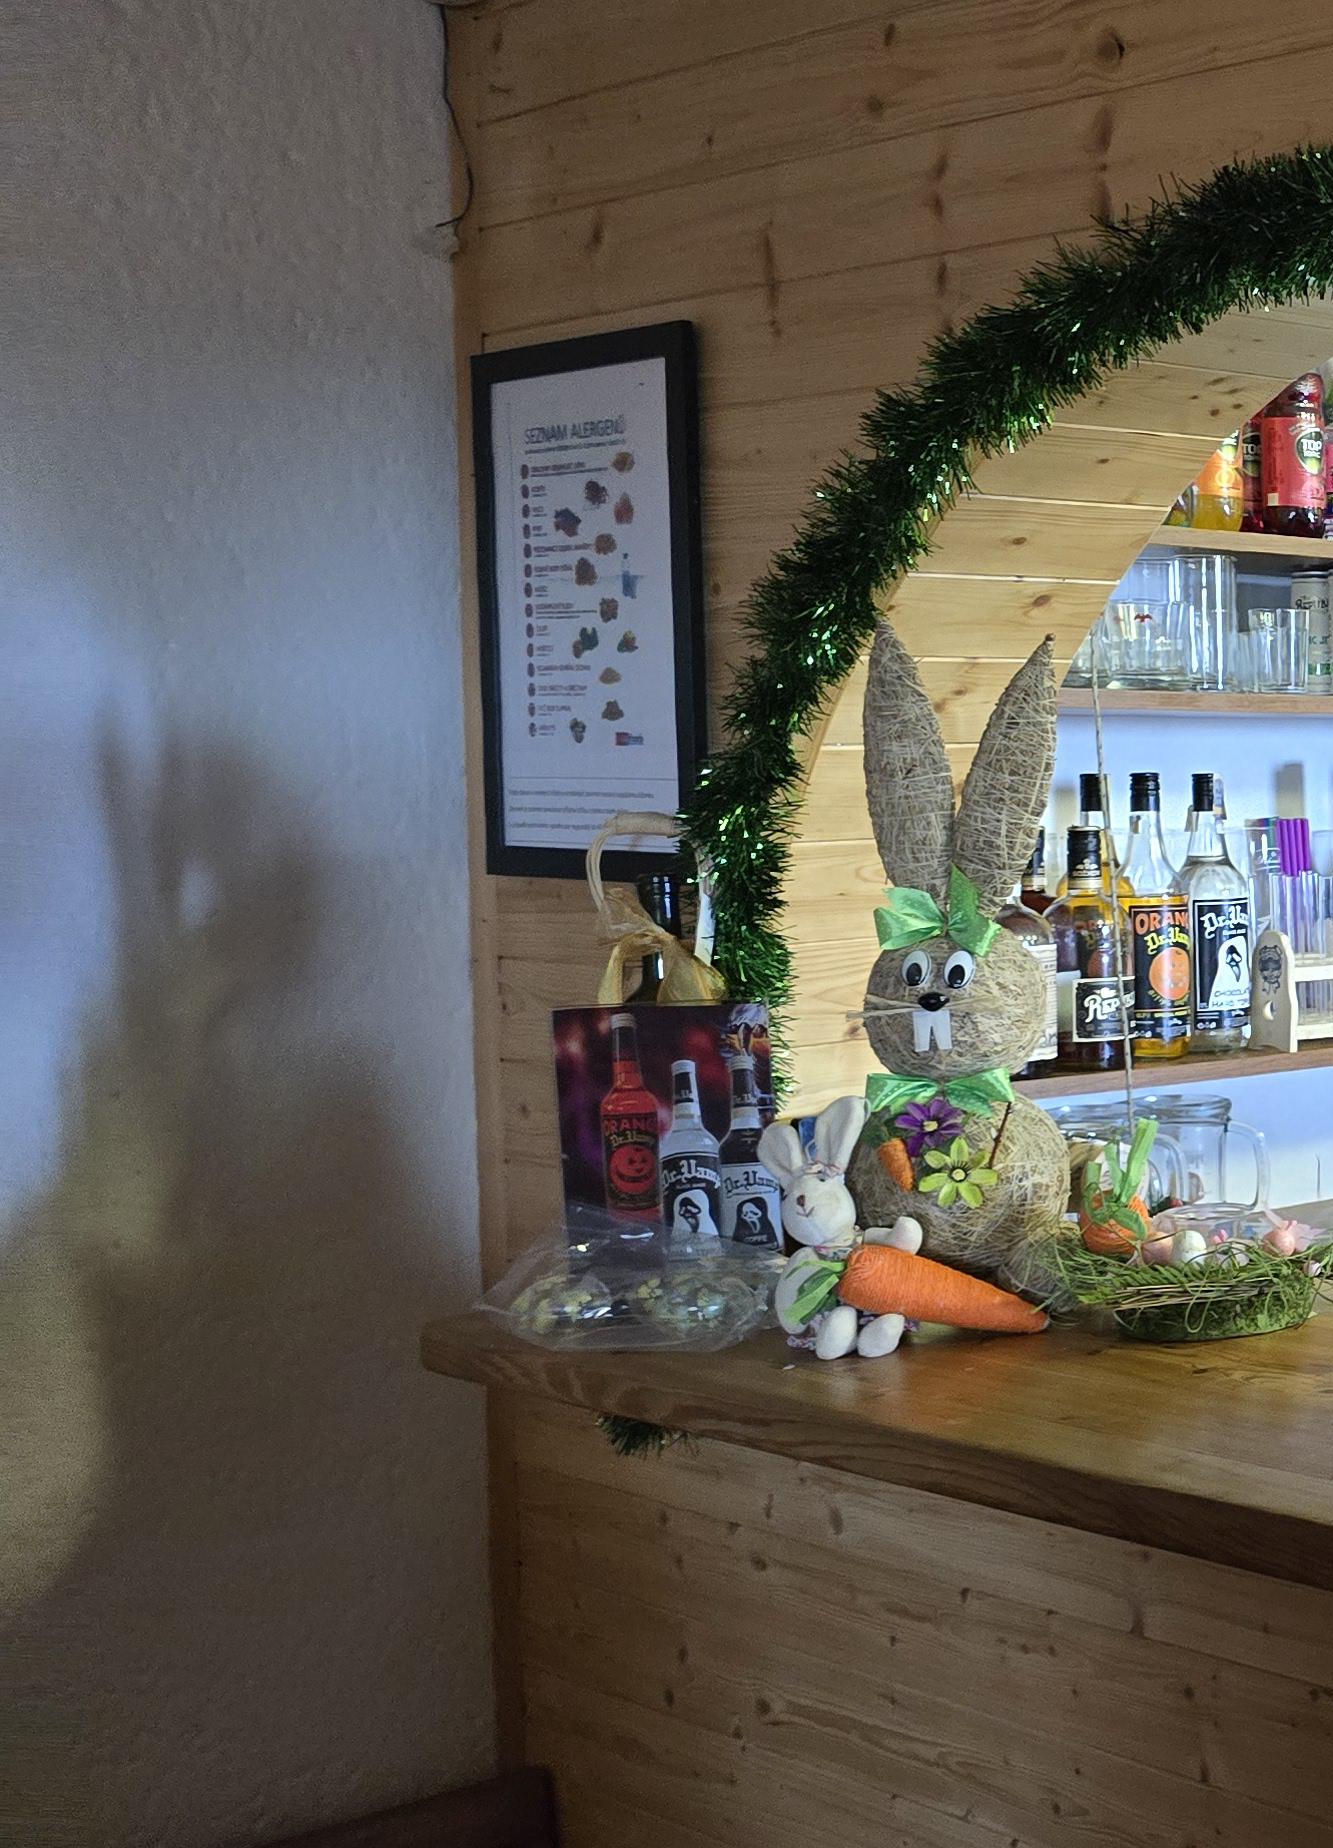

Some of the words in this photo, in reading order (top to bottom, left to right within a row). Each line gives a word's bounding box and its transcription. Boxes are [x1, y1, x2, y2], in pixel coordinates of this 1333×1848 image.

[1242, 443, 1261, 455] TO
[1135, 911, 1189, 935] ORAN
[603, 1117, 656, 1137] ORAN
